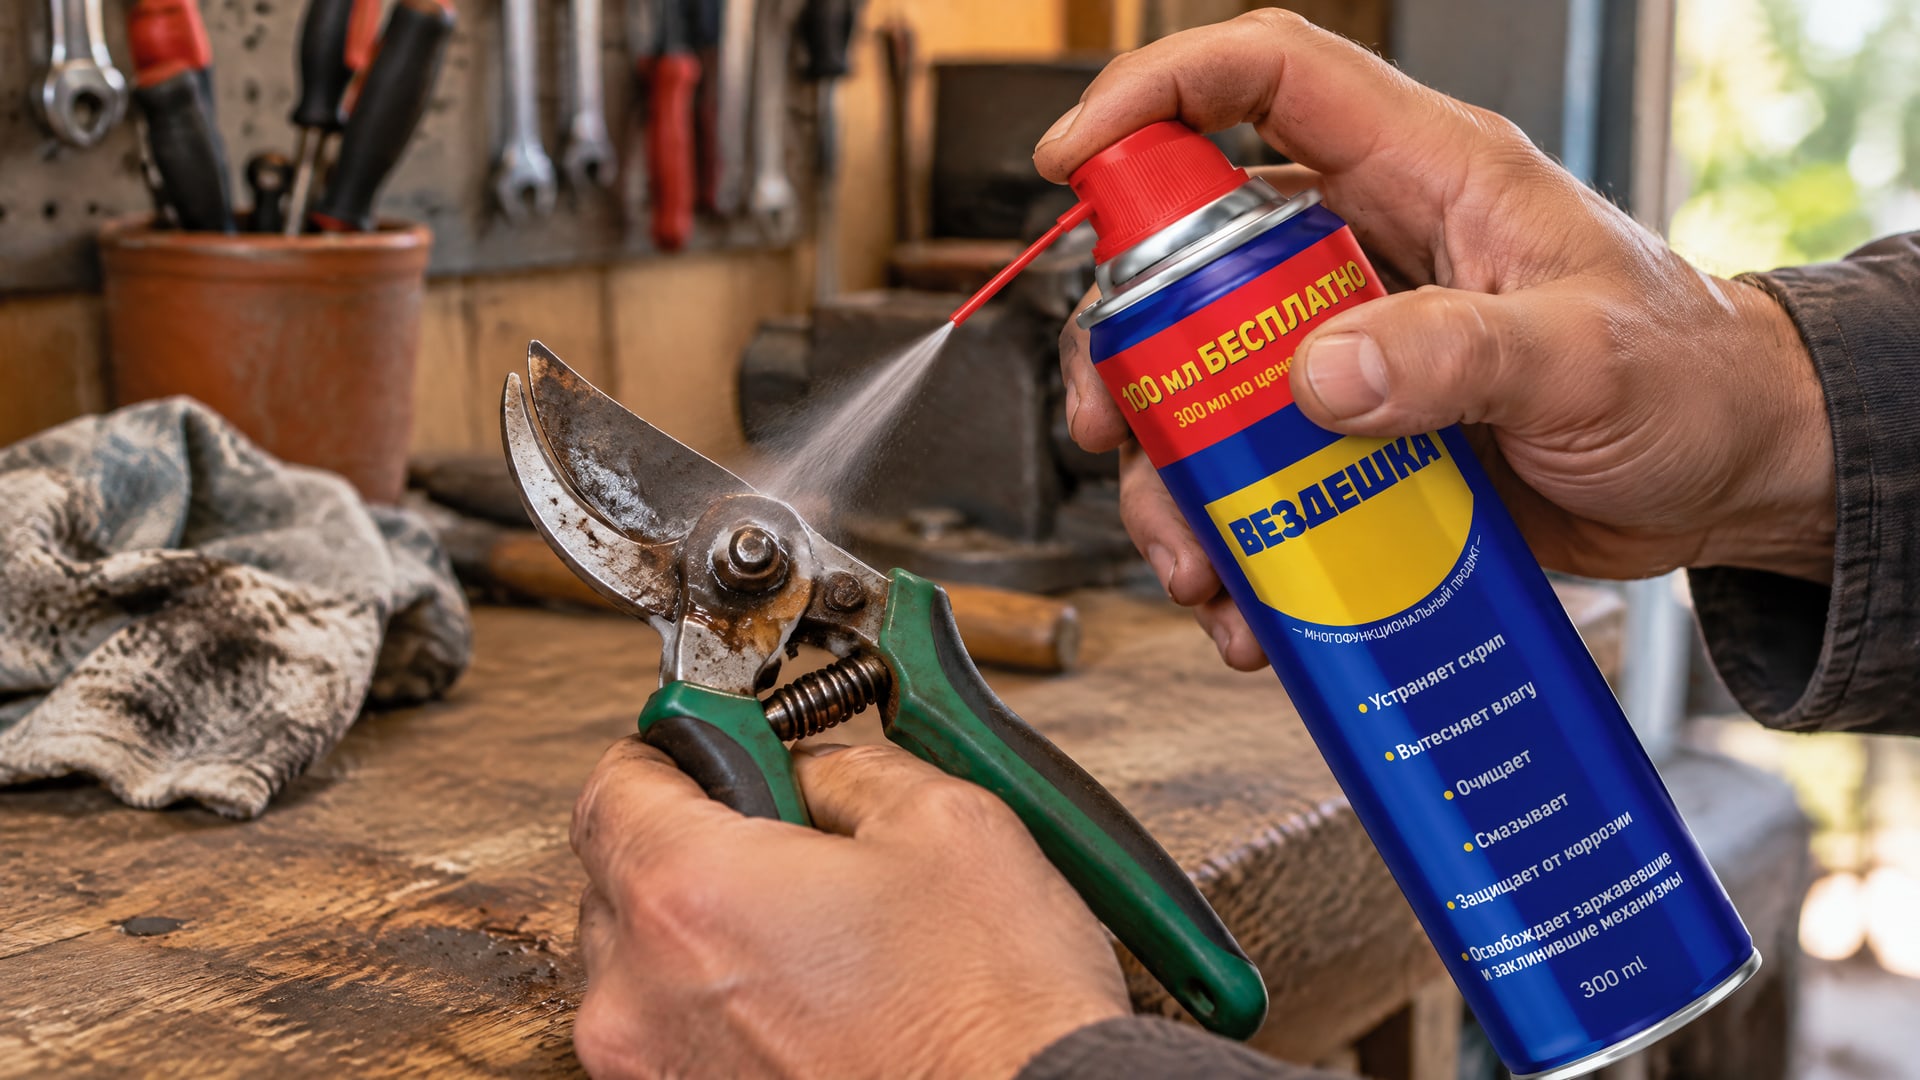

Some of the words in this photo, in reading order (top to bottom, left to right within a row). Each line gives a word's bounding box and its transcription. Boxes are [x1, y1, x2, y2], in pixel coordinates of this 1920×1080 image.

[1122, 375, 1163, 413] 100
[1160, 360, 1202, 395] мл
[1197, 260, 1367, 376] БЕСПЛАТНО
[1174, 402, 1207, 428] 300
[1207, 391, 1232, 415] мл
[1231, 381, 1254, 401] по
[1228, 434, 1442, 557] ВЕЗДЕШКА
[1304, 584, 1455, 643] МНОГОФУНКЦИОНАЛЬНЫЙ
[1450, 545, 1481, 592] ПРОДУКТ
[1368, 661, 1457, 711] Устраняет
[1458, 633, 1506, 669] скрип
[1395, 708, 1490, 760] Вытесняет
[1491, 681, 1537, 716] влагу
[1456, 750, 1532, 796] Очищает
[1456, 864, 1541, 909] Защищает
[1542, 853, 1563, 872] от
[1564, 811, 1633, 861] коррозии
[1475, 793, 1569, 849] Смазывает
[1469, 911, 1572, 962] Освобождает
[1573, 851, 1673, 919] заржавевшие
[1480, 967, 1493, 981] и
[1492, 922, 1600, 978] заклинившие
[1600, 871, 1684, 931] механизмы
[1579, 968, 1619, 999] 300
[1621, 955, 1648, 980] ml
